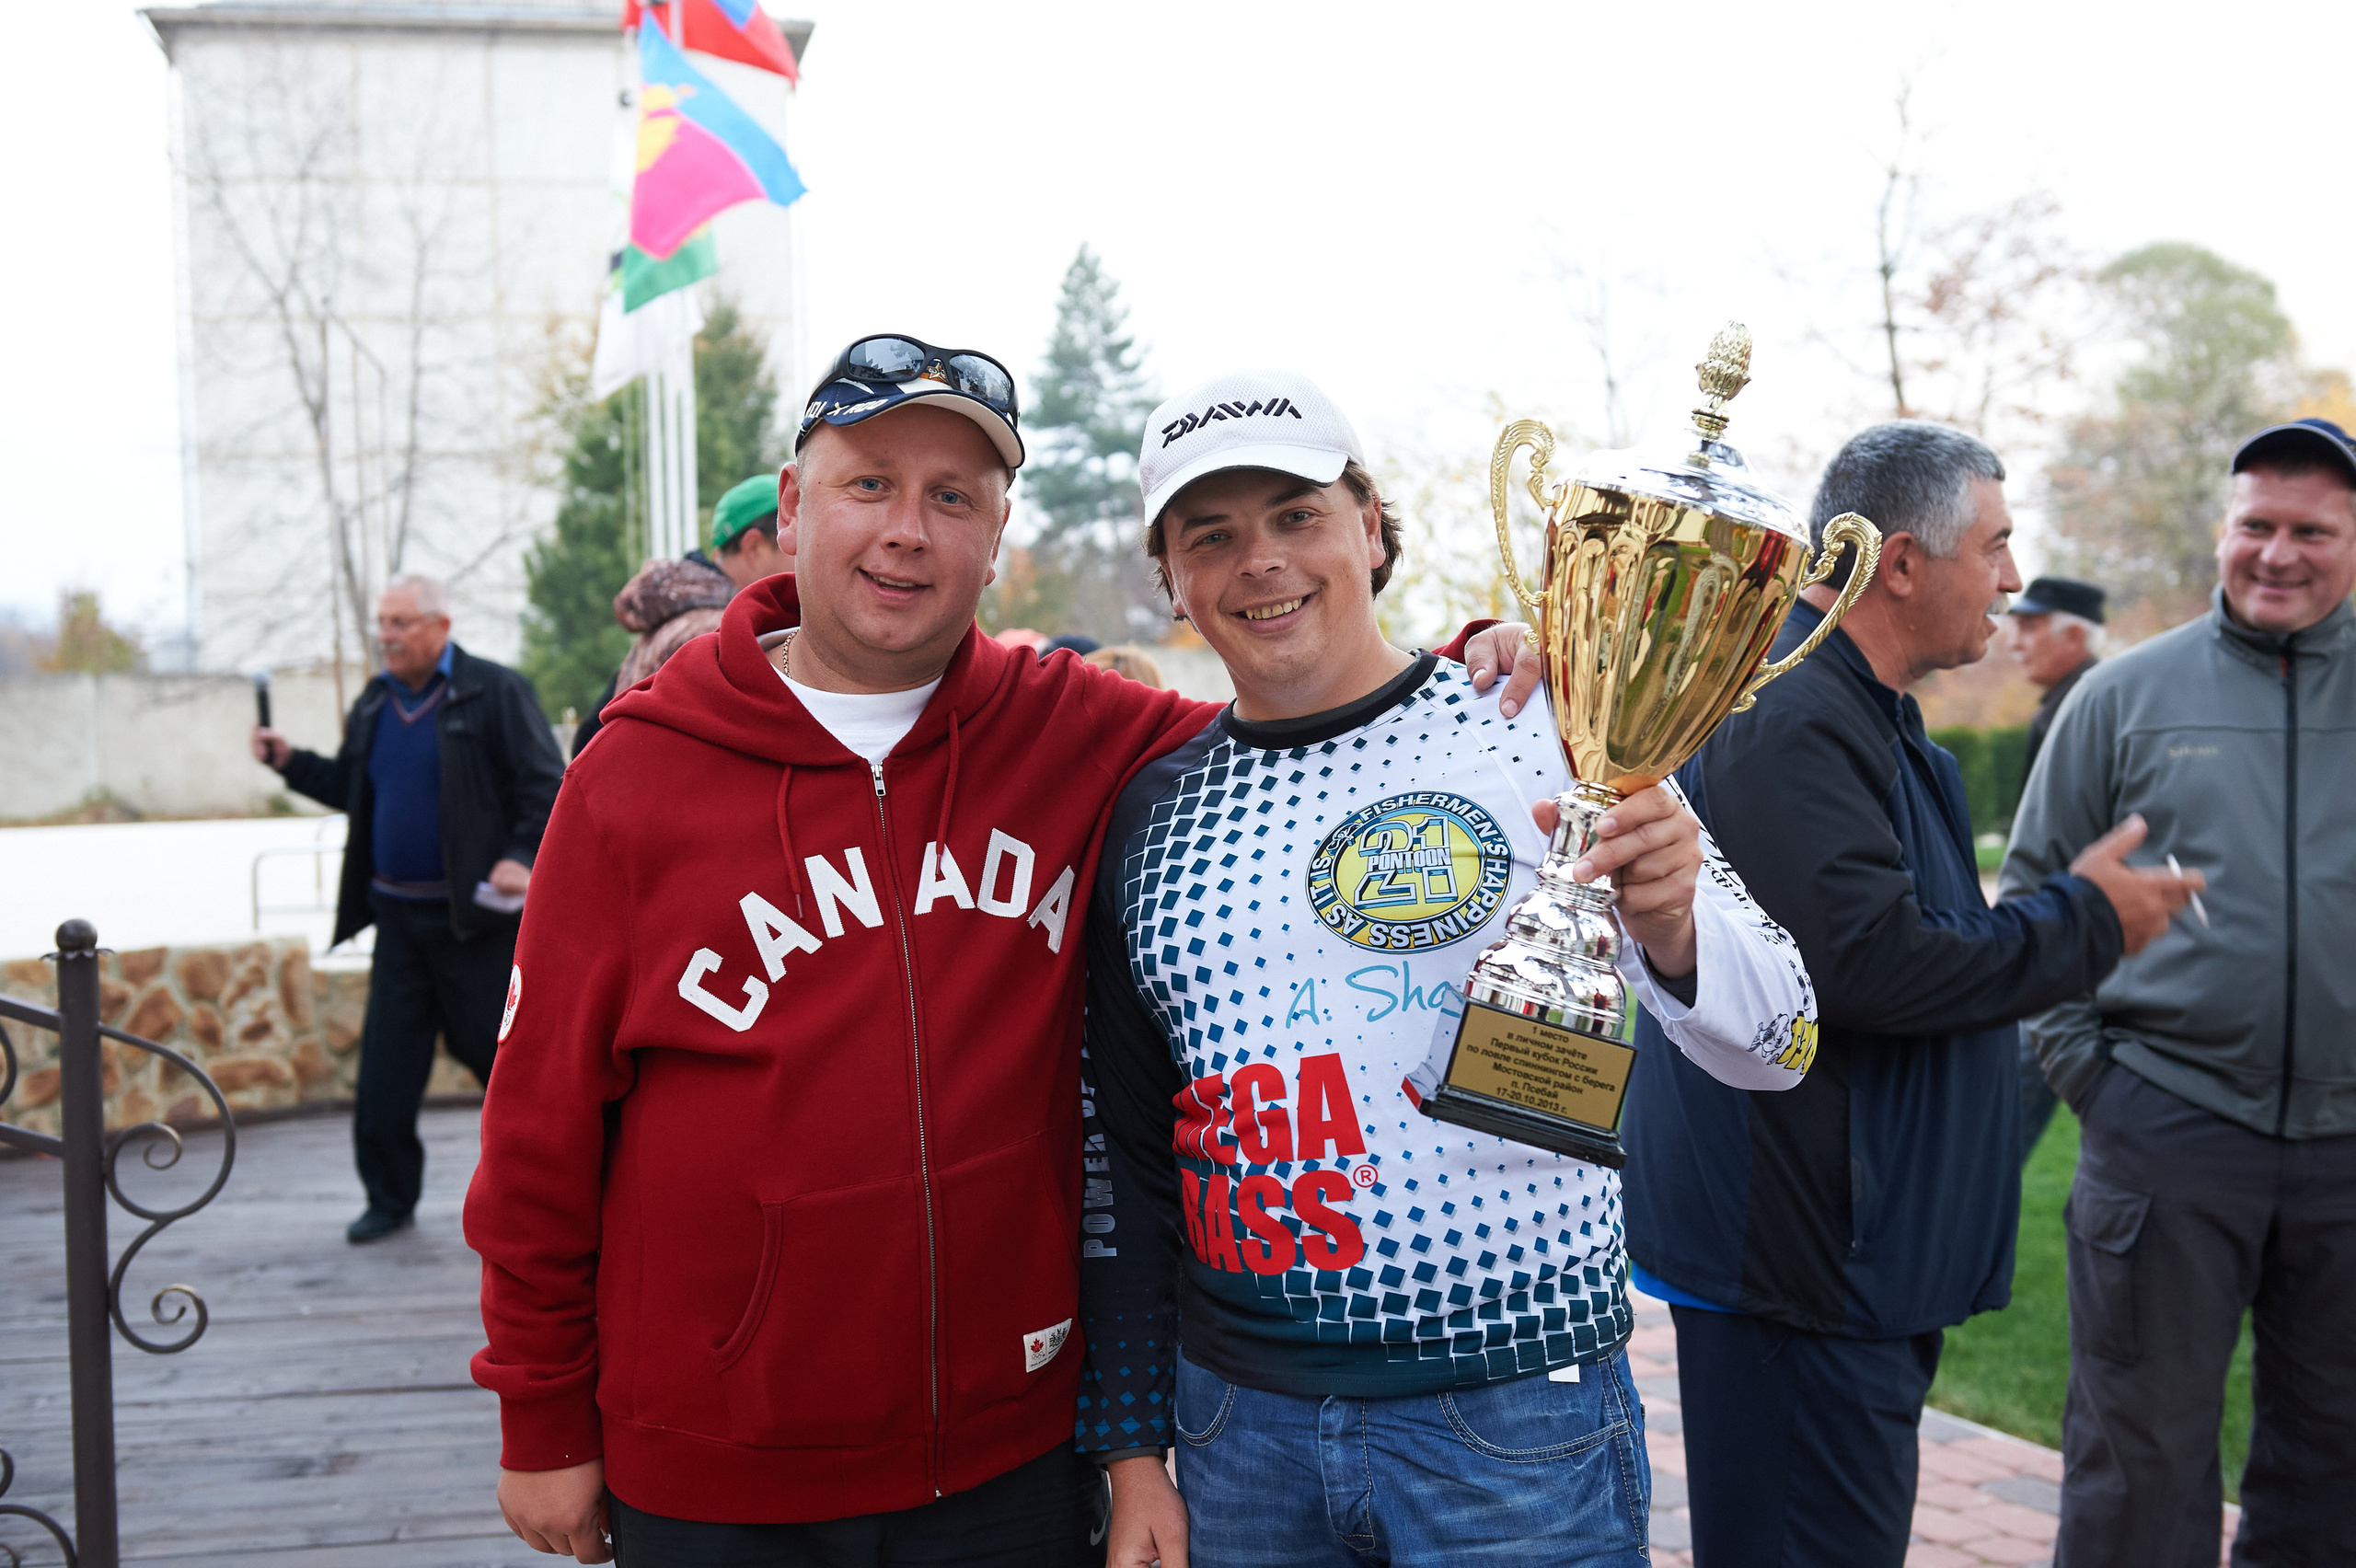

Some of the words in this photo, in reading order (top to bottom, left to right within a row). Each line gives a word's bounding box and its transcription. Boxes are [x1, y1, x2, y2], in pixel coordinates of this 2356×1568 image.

[1161, 398, 1302, 449] DAIWA
[1358, 792, 1509, 858] FISHERMEN'S
[1310, 855, 1334, 882] IS
[1368, 847, 1451, 873] PONTOON
[1310, 882, 1338, 910] IT
[1368, 857, 1508, 949] HAPPINESS
[678, 827, 1075, 1032] CANADA
[1325, 903, 1369, 938] AS
[1507, 1032, 1514, 1040] в
[1516, 1034, 1553, 1051] личном
[1532, 1025, 1538, 1034] 1
[1540, 1030, 1569, 1043] место
[1466, 1043, 1480, 1054] по
[1481, 1048, 1512, 1063] ловле
[1513, 1057, 1573, 1079] спиннингом
[1574, 1074, 1581, 1082] с
[1582, 1075, 1616, 1092] берега
[1491, 1037, 1530, 1055] Первый
[1532, 1051, 1561, 1066] кубок
[1562, 1057, 1599, 1075] России
[1492, 1061, 1552, 1086] Мостовской
[1553, 1080, 1584, 1095] район
[1511, 1080, 1520, 1090] п.
[1522, 1081, 1559, 1100] Псебай
[1496, 1087, 1560, 1112] 17-20.10.2013
[1561, 1105, 1568, 1115] г.
[1082, 1133, 1117, 1258] POWER
[1180, 1170, 1364, 1276] BASS
